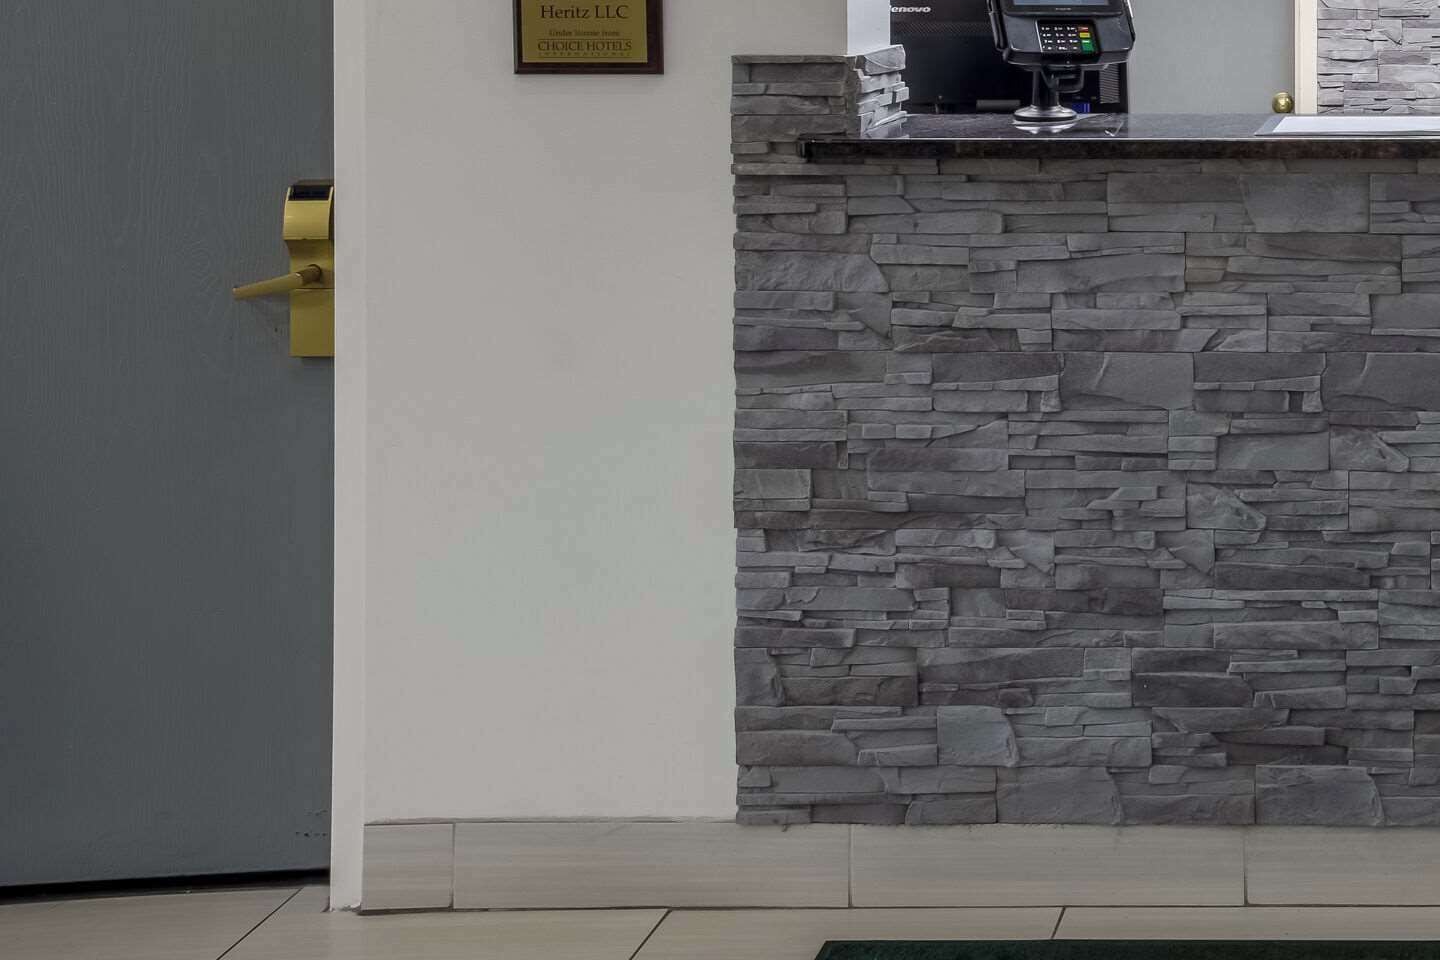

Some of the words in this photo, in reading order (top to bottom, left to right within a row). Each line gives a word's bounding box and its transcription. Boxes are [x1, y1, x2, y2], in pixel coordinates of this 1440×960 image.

[541, 5, 590, 19] Heritz
[595, 5, 629, 19] LLC
[538, 41, 584, 51] CHOICE
[586, 41, 632, 51] HOTELS
